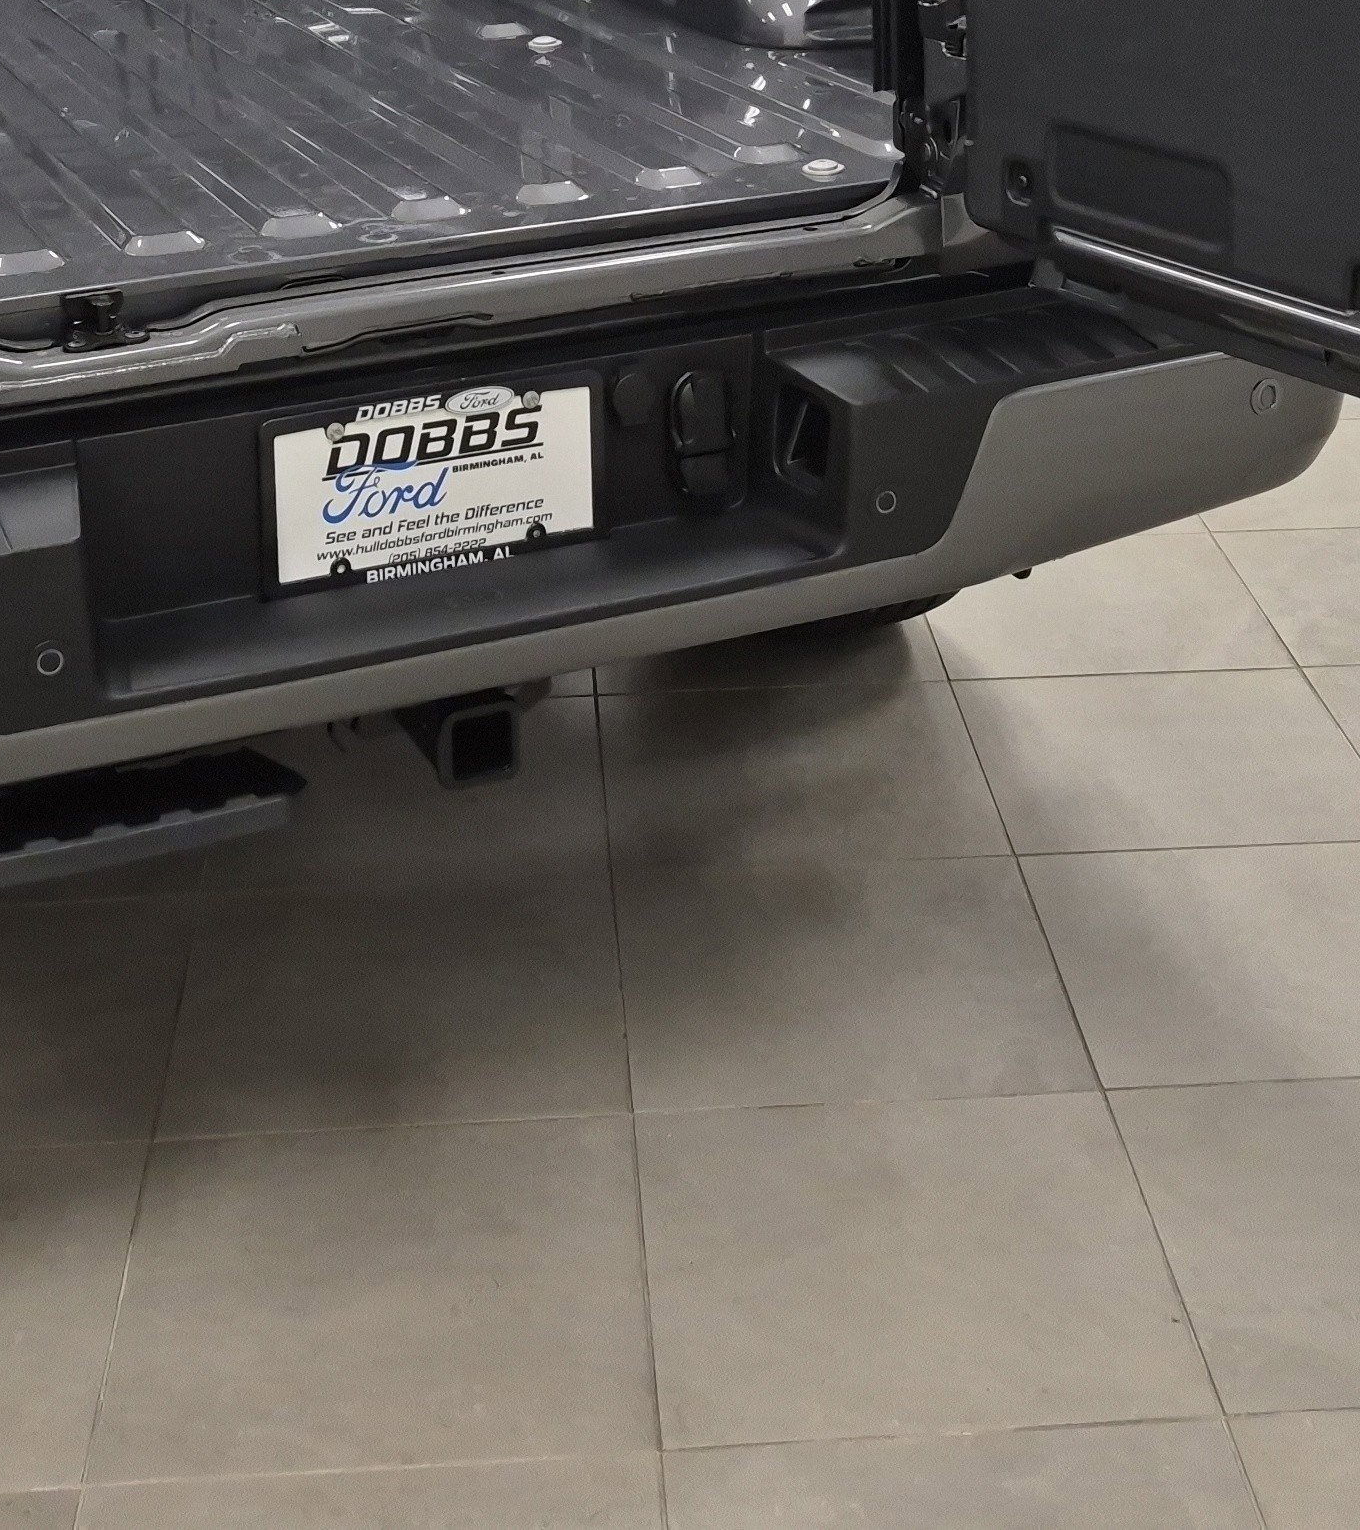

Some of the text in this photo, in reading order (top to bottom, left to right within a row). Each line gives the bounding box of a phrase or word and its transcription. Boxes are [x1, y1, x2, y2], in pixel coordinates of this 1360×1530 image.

[355, 391, 500, 422] DOBBS Ford
[325, 404, 543, 477] DOBBS
[452, 451, 544, 473] BIRMINGHAM, AL
[322, 459, 449, 524] Ford
[316, 512, 553, 561] www.hulldobbsfordbirmingham.com
[325, 498, 544, 545] See and Feel the Difference
[493, 545, 515, 561] AL
